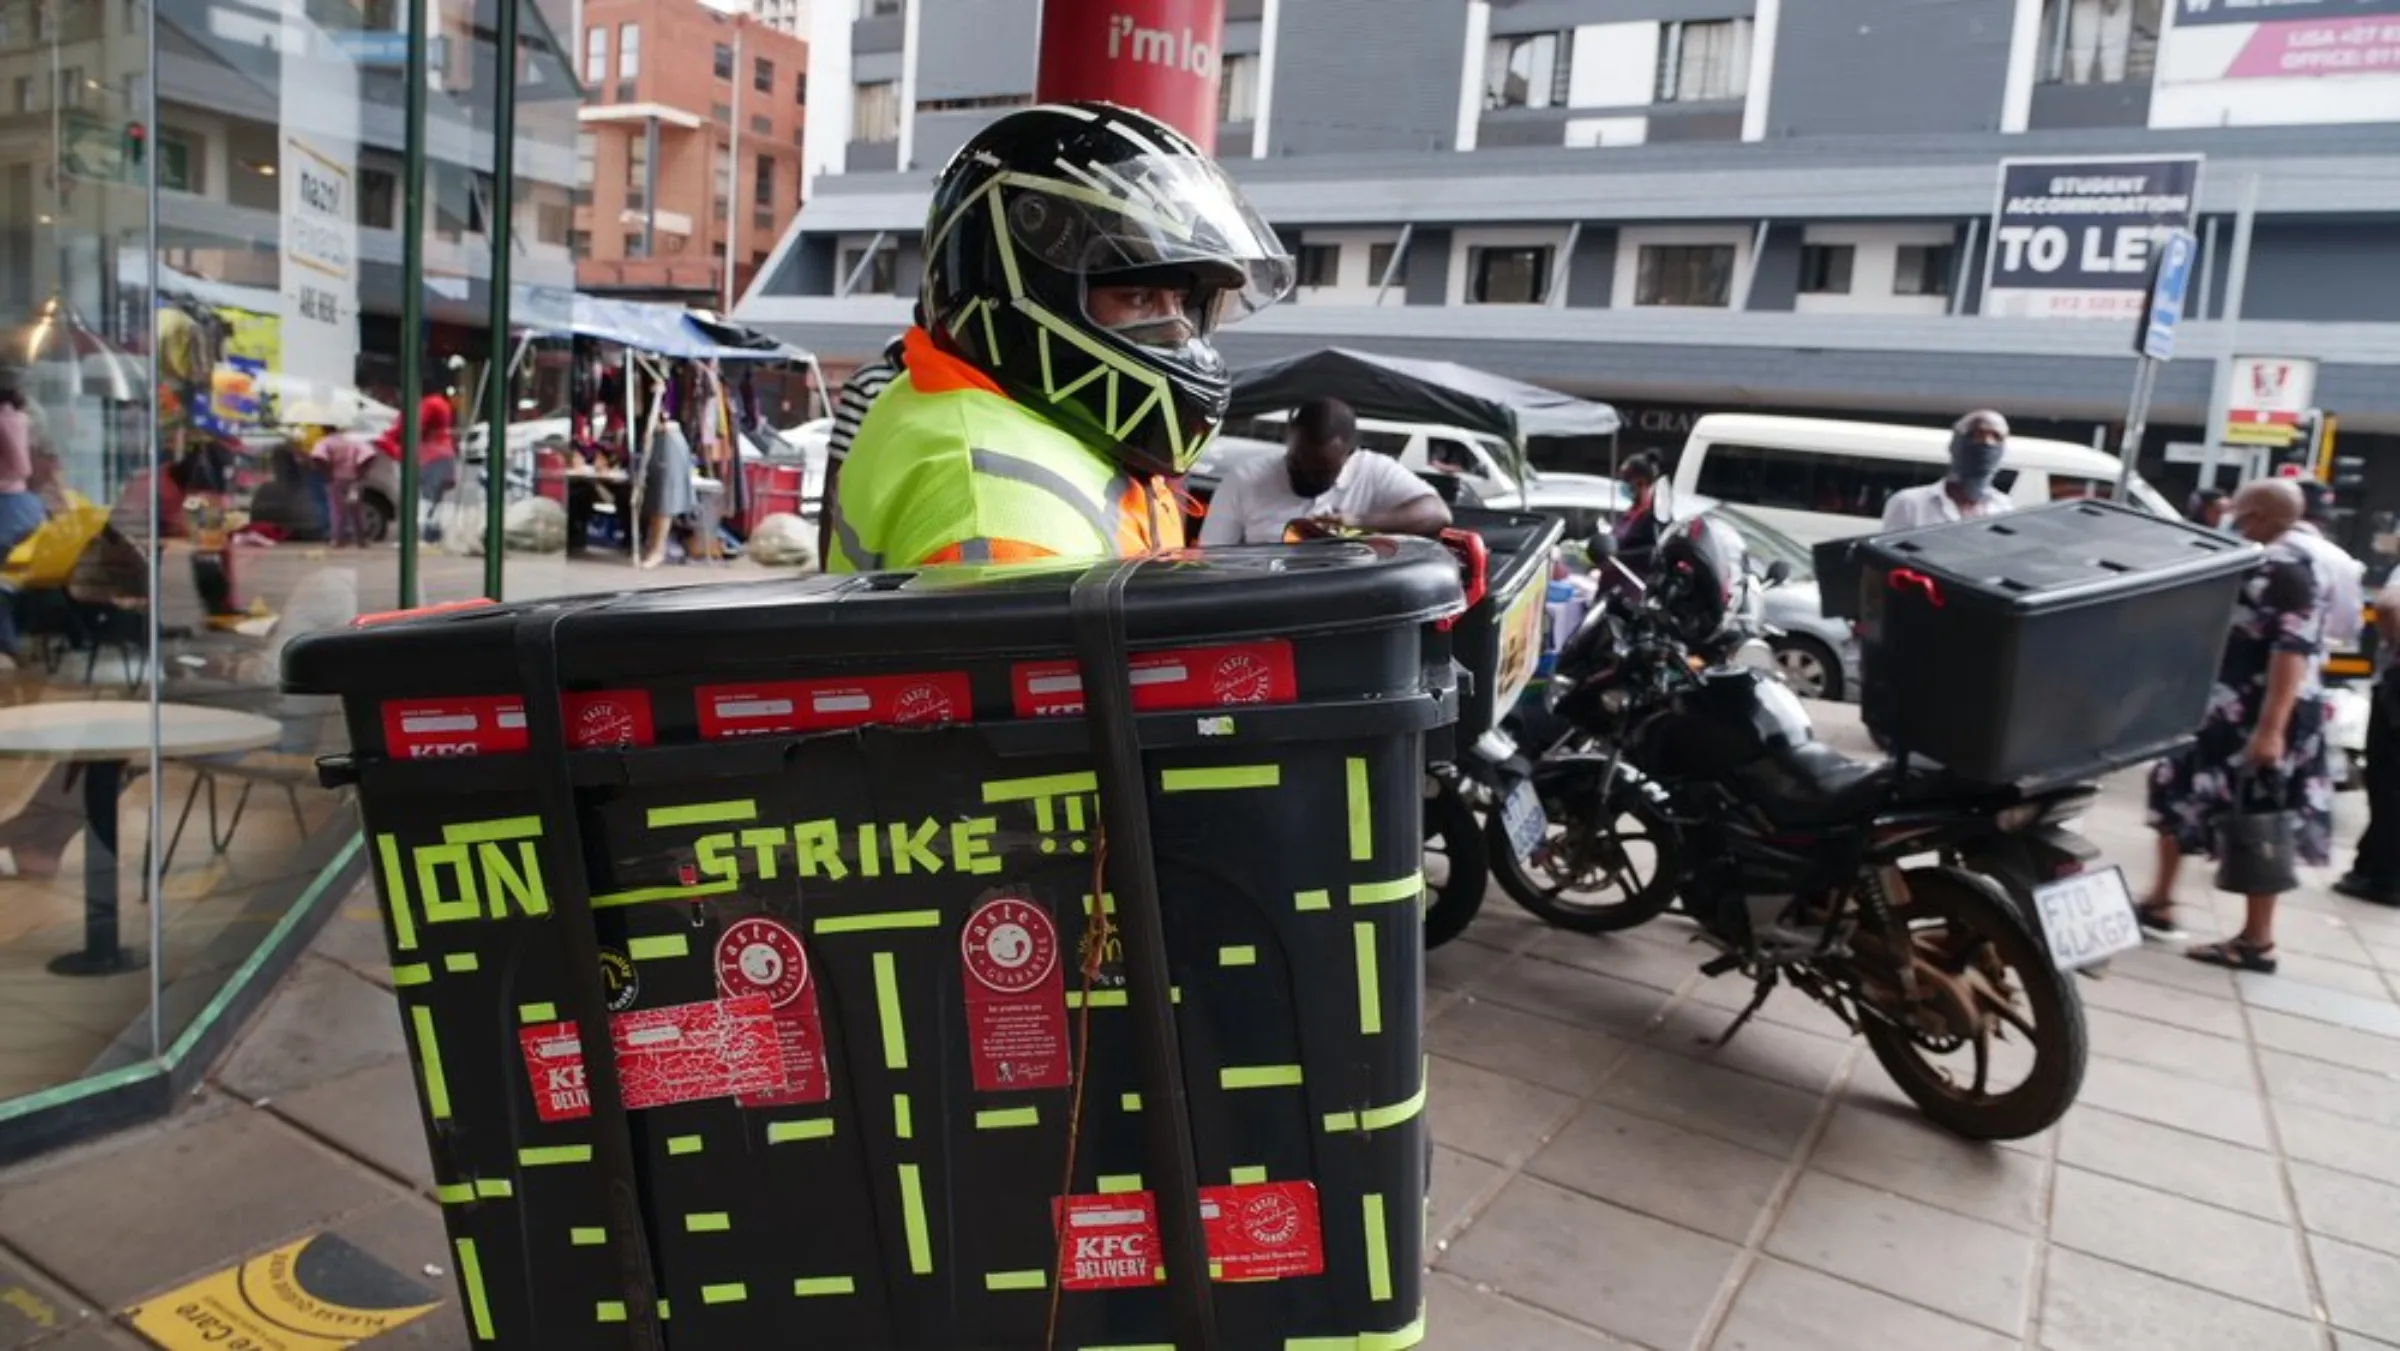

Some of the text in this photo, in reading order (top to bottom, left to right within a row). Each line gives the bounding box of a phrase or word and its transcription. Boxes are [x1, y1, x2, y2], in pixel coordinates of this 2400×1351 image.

[2006, 194, 2189, 215] ACCOMMODATION
[2049, 176, 2148, 195] STUDENT
[1999, 225, 2068, 272] TO
[694, 815, 1003, 894] STRIKE
[413, 842, 550, 923] ON
[722, 922, 779, 973] Taste
[969, 903, 1029, 954] Taste
[1076, 1234, 1144, 1259] KFC
[1075, 1257, 1146, 1280] DELIVERY
[175, 1302, 233, 1341] Care
